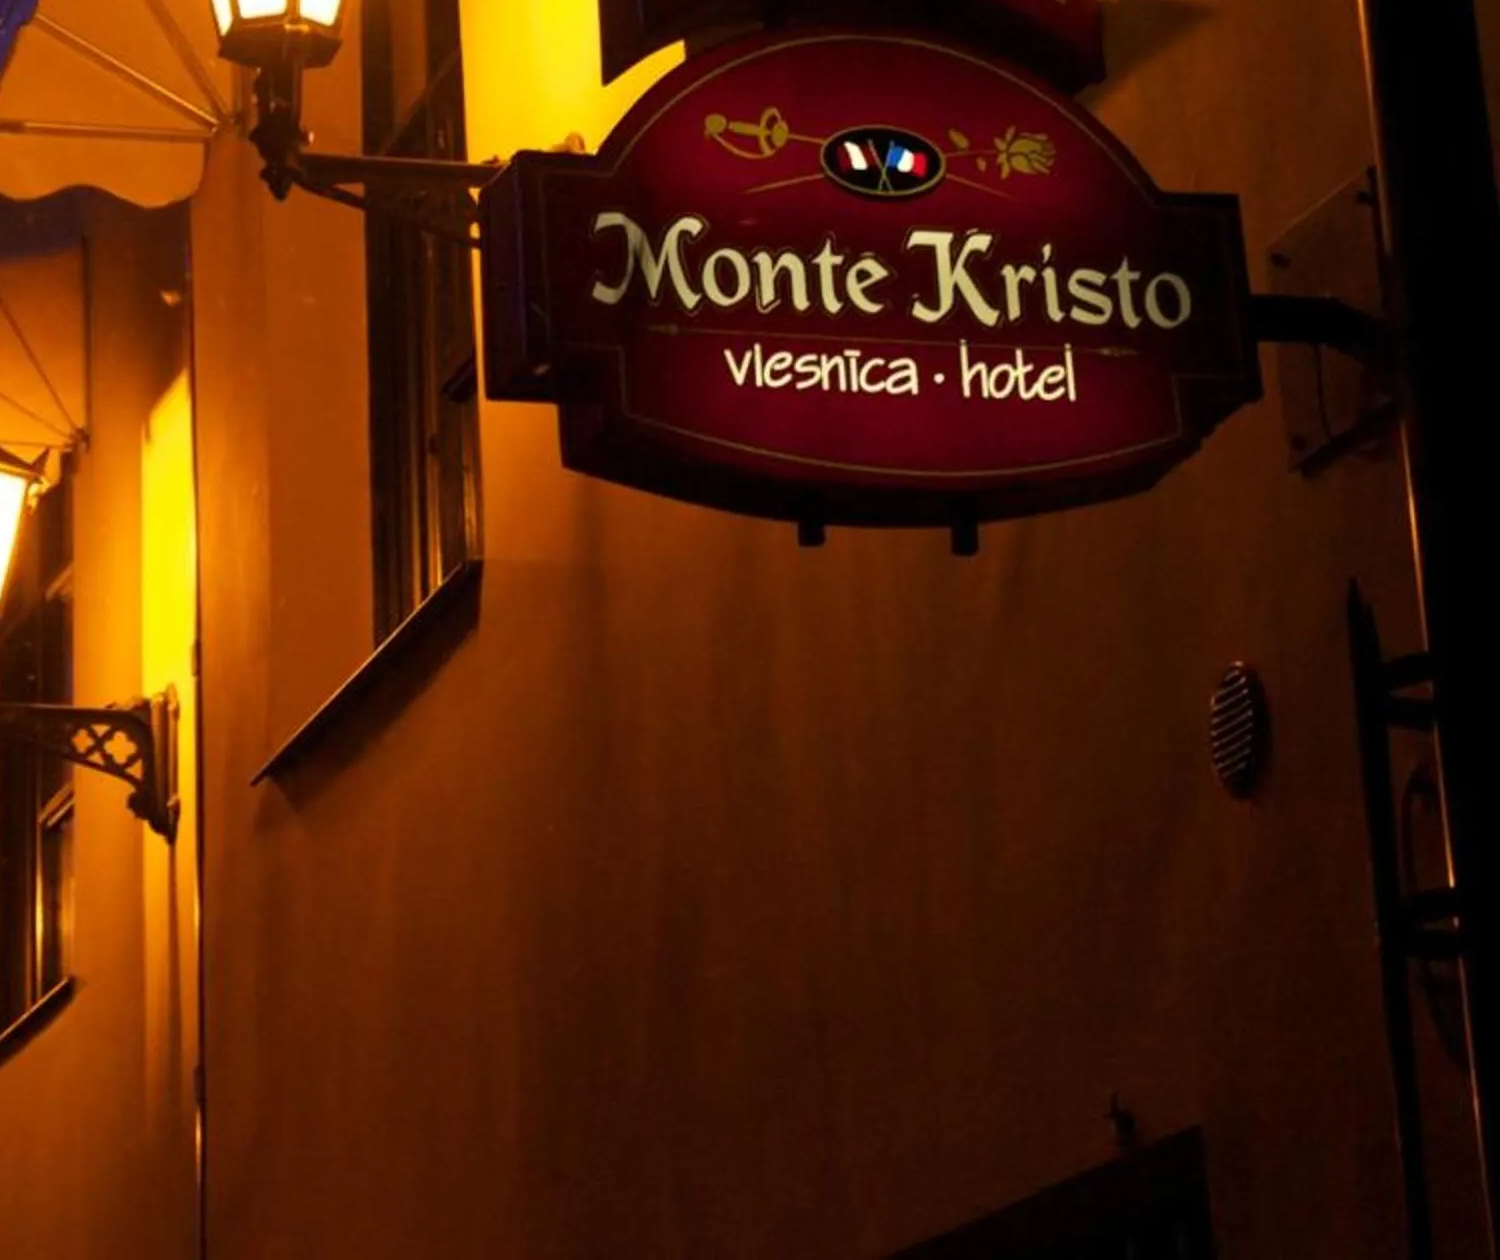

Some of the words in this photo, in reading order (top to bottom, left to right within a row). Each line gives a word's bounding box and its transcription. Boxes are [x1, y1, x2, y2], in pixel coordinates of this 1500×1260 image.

[591, 211, 890, 315] Monte
[905, 228, 1193, 330] Kristo
[958, 338, 1078, 403] hotel
